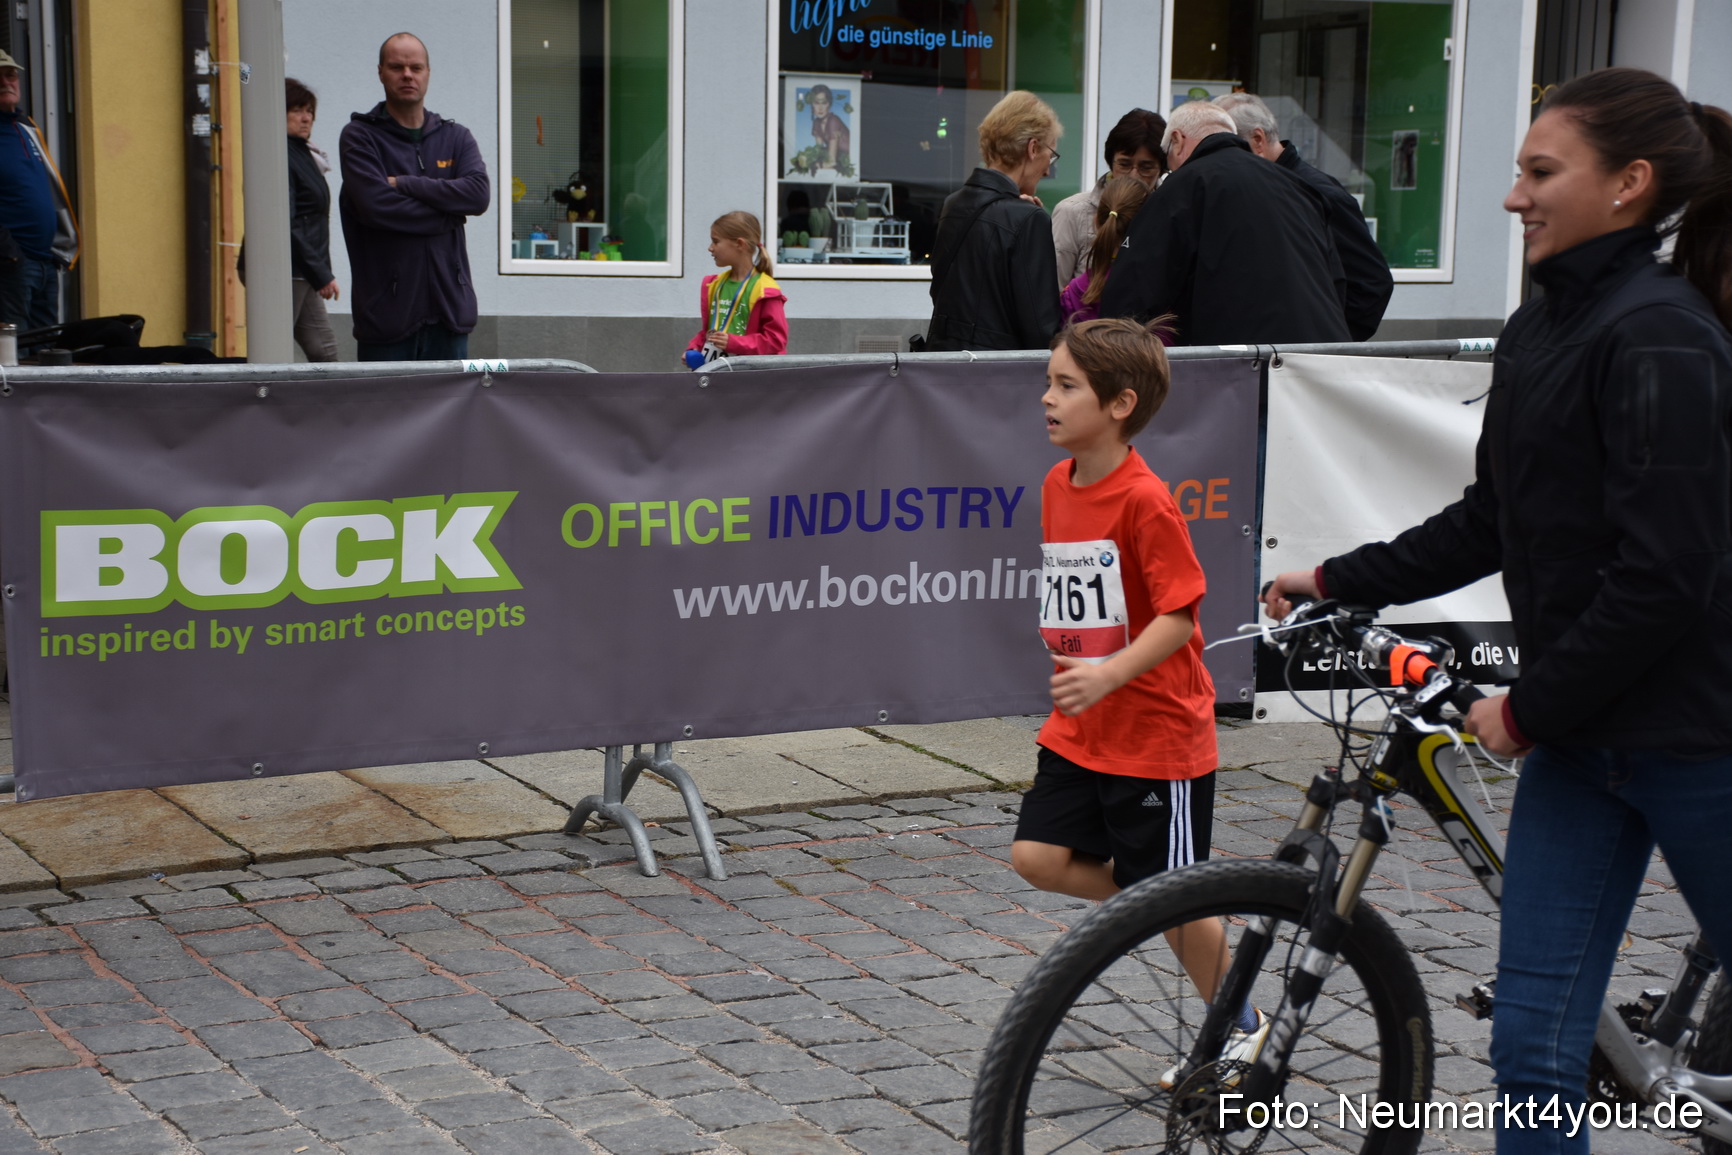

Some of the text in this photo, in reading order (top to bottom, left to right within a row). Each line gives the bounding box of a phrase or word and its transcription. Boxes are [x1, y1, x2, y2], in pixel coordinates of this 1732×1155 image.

[837, 25, 993, 50] die günstige Linie
[560, 486, 1026, 549] OFFICE INDUSTRY
[55, 505, 500, 603] BOCK
[1056, 556, 1096, 568] Neumarkt
[1043, 572, 1108, 622] 7161
[40, 601, 527, 662] inspired by smart concepts
[1060, 634, 1082, 653] Fati
[1471, 642, 1504, 666] die
